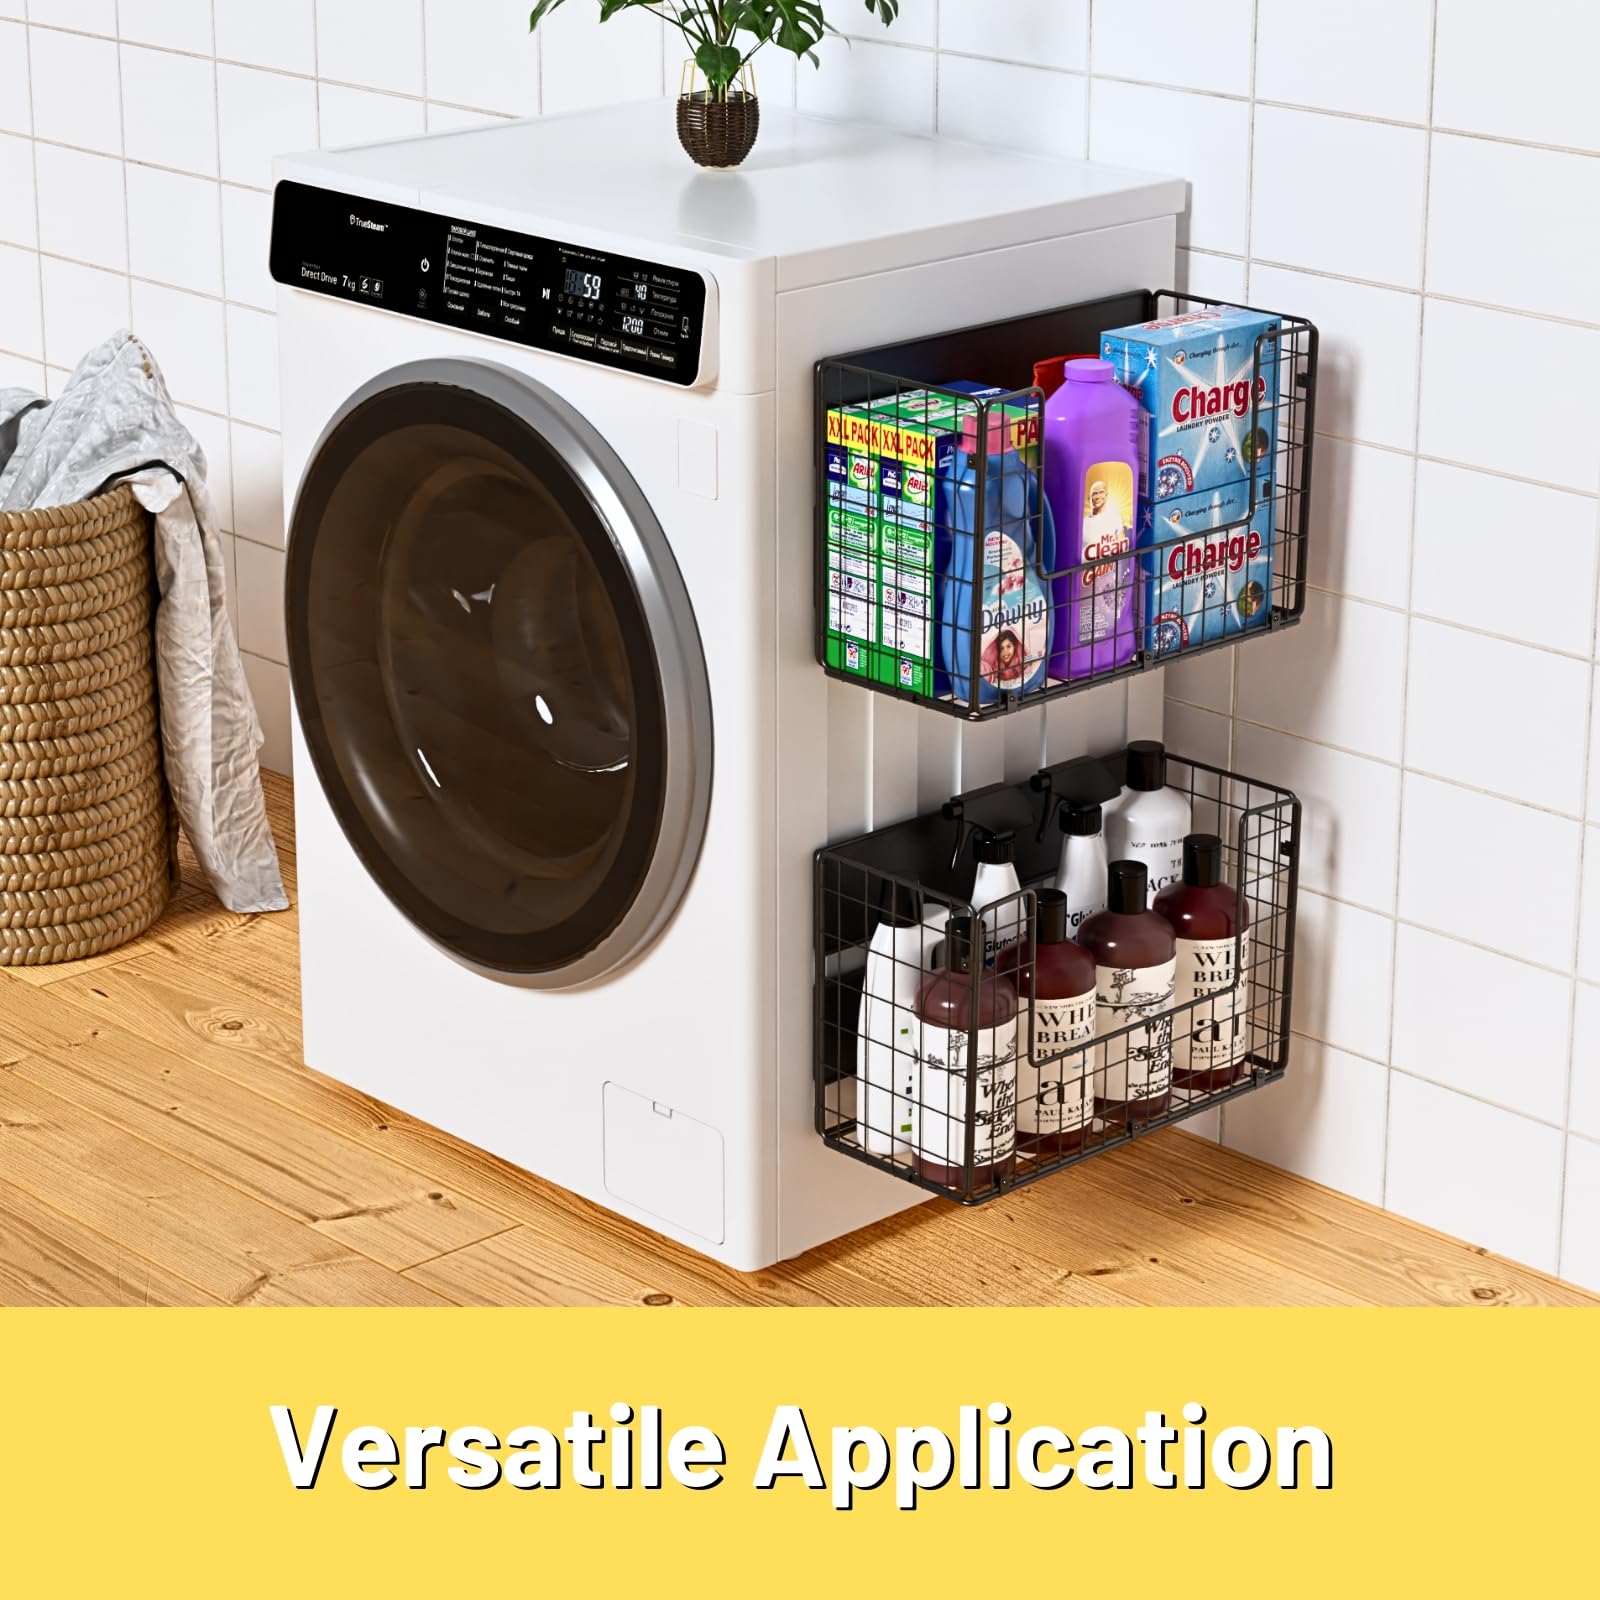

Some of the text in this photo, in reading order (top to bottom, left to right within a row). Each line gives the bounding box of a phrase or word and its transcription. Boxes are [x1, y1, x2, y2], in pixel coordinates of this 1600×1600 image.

[301, 266, 320, 281] Direct
[321, 271, 338, 286] Drive
[583, 274, 601, 300] 59
[635, 285, 647, 300] 40
[622, 316, 644, 335] 1200
[1176, 413, 1230, 432] LAUNDRY POWDER
[1101, 534, 1115, 544] Mr.
[1084, 539, 1129, 561] Clean
[1168, 531, 1261, 580] Charge
[981, 600, 1043, 634] Downy
